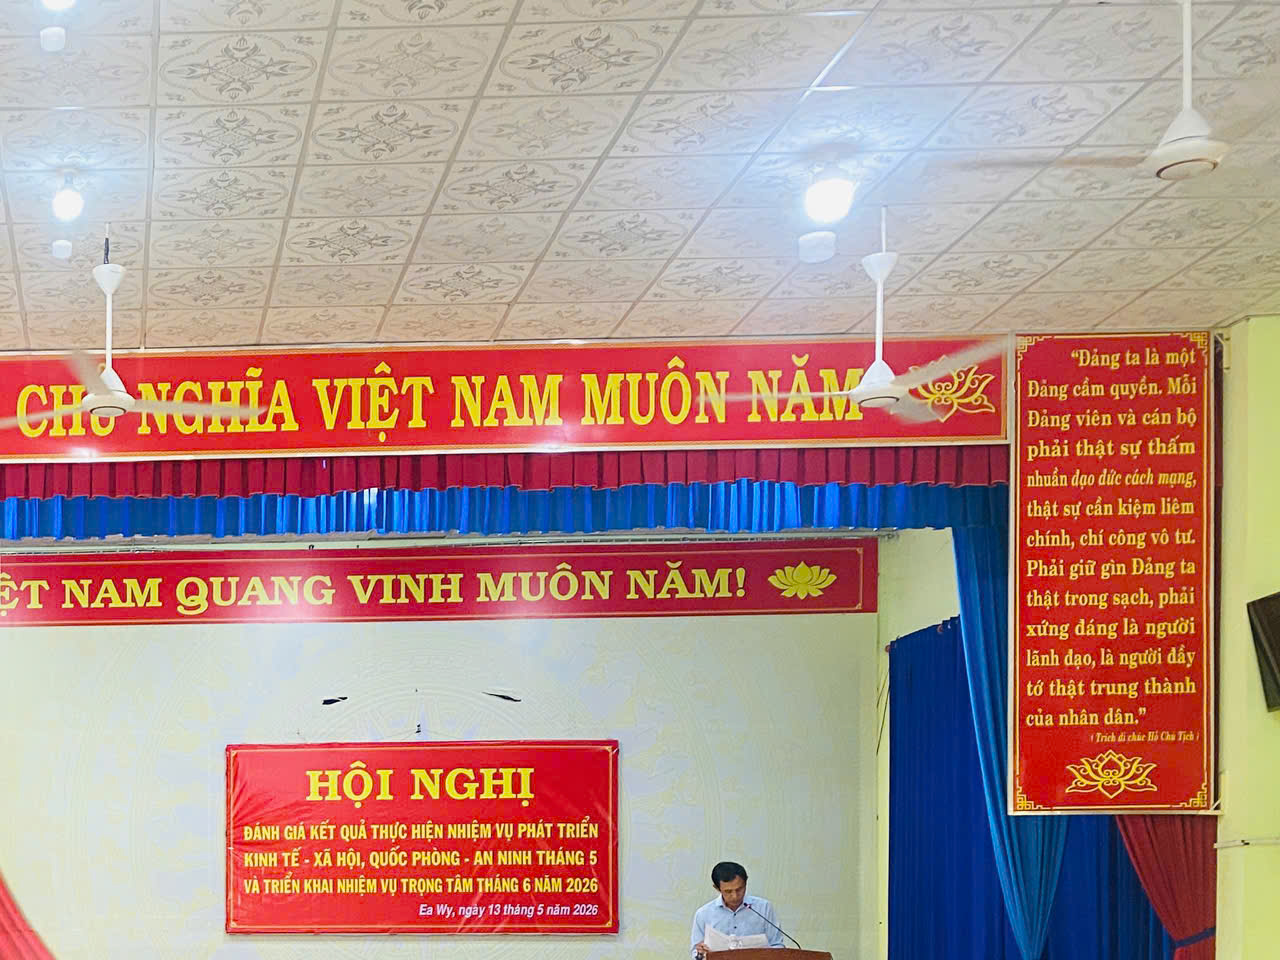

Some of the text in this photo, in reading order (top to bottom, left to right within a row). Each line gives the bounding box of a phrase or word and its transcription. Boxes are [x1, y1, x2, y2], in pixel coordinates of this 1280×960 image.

[1125, 350, 1140, 365] ta
[1145, 348, 1160, 365] là
[1166, 348, 1195, 367] một
[137, 367, 299, 435] NGHĨA
[312, 361, 435, 443] VIỆT
[451, 374, 563, 428] NAM
[581, 356, 730, 425] MUÔN
[747, 353, 864, 422] NĂM
[1028, 374, 1196, 401] Đảng cầm quyền. Mỗi
[1028, 407, 1196, 431] Đảng viên và cán bộ
[1028, 435, 1195, 461] phải thật sự thấm
[1027, 496, 1194, 520] thật sự cần kiệm liêm
[1027, 528, 1195, 549] chính, chí công vô tư.
[1027, 557, 1195, 580] Phải giữ gìn Đảng ta
[62, 578, 163, 609] NAM
[175, 576, 336, 616] QUANG
[347, 572, 464, 604] VINH
[476, 562, 613, 602] MUÔN
[626, 560, 747, 600] NĂM!
[1027, 586, 1194, 610] thật trong sạch, phải
[1026, 617, 1195, 640] xứng đáng là người
[1027, 677, 1196, 699] tớ thật trung thành
[1026, 708, 1054, 726] của
[1059, 709, 1099, 725] nhân
[306, 761, 534, 808] HỘI NGHỊ
[244, 816, 598, 842] ĐÁNH GIÁ KẾT QUẢ THỰC HIỆN NHIỆM VỤ PHÁT TRIỂN
[244, 852, 278, 867] KINH
[282, 847, 302, 867] TẾ
[314, 848, 332, 866] XÃ
[337, 848, 365, 869] HỘI,
[370, 846, 407, 869] QUỐC
[412, 848, 460, 866] PHÒNG
[474, 851, 493, 865] AN
[498, 851, 531, 865] NINH
[536, 847, 584, 865] THÁNG
[590, 851, 597, 865] 5
[244, 872, 598, 896] VÀ TRIỂN KHAI NHIỆM VỤ TRỌNG TÂM THÁNG 6 NĂM 2026
[419, 904, 598, 918] Ea Wy, ngày 13 tháng 5 năm 2026
